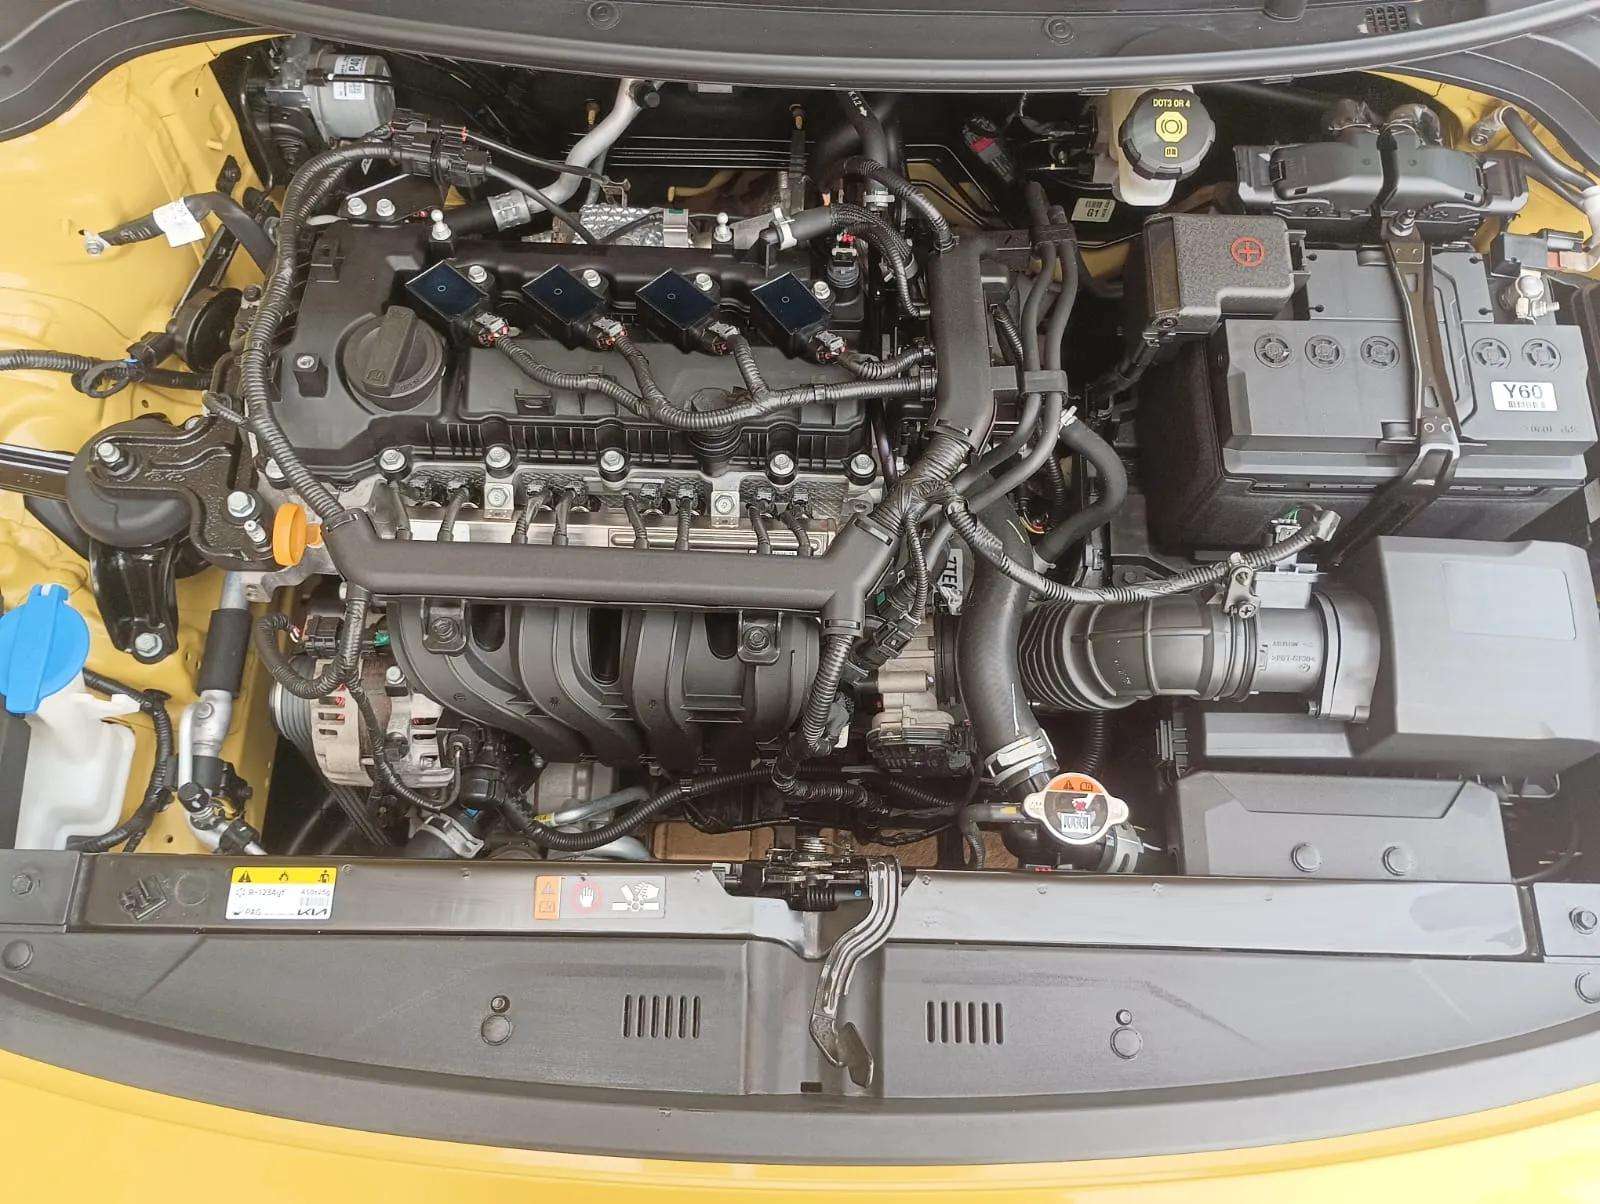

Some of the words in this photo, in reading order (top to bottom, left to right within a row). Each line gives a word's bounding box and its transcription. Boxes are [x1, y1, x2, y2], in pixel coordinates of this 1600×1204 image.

[1153, 98, 1172, 107] DOT3
[1173, 99, 1184, 107] OR
[1185, 99, 1191, 107] 4
[1503, 383, 1543, 399] Y60
[298, 908, 327, 916] KIA
